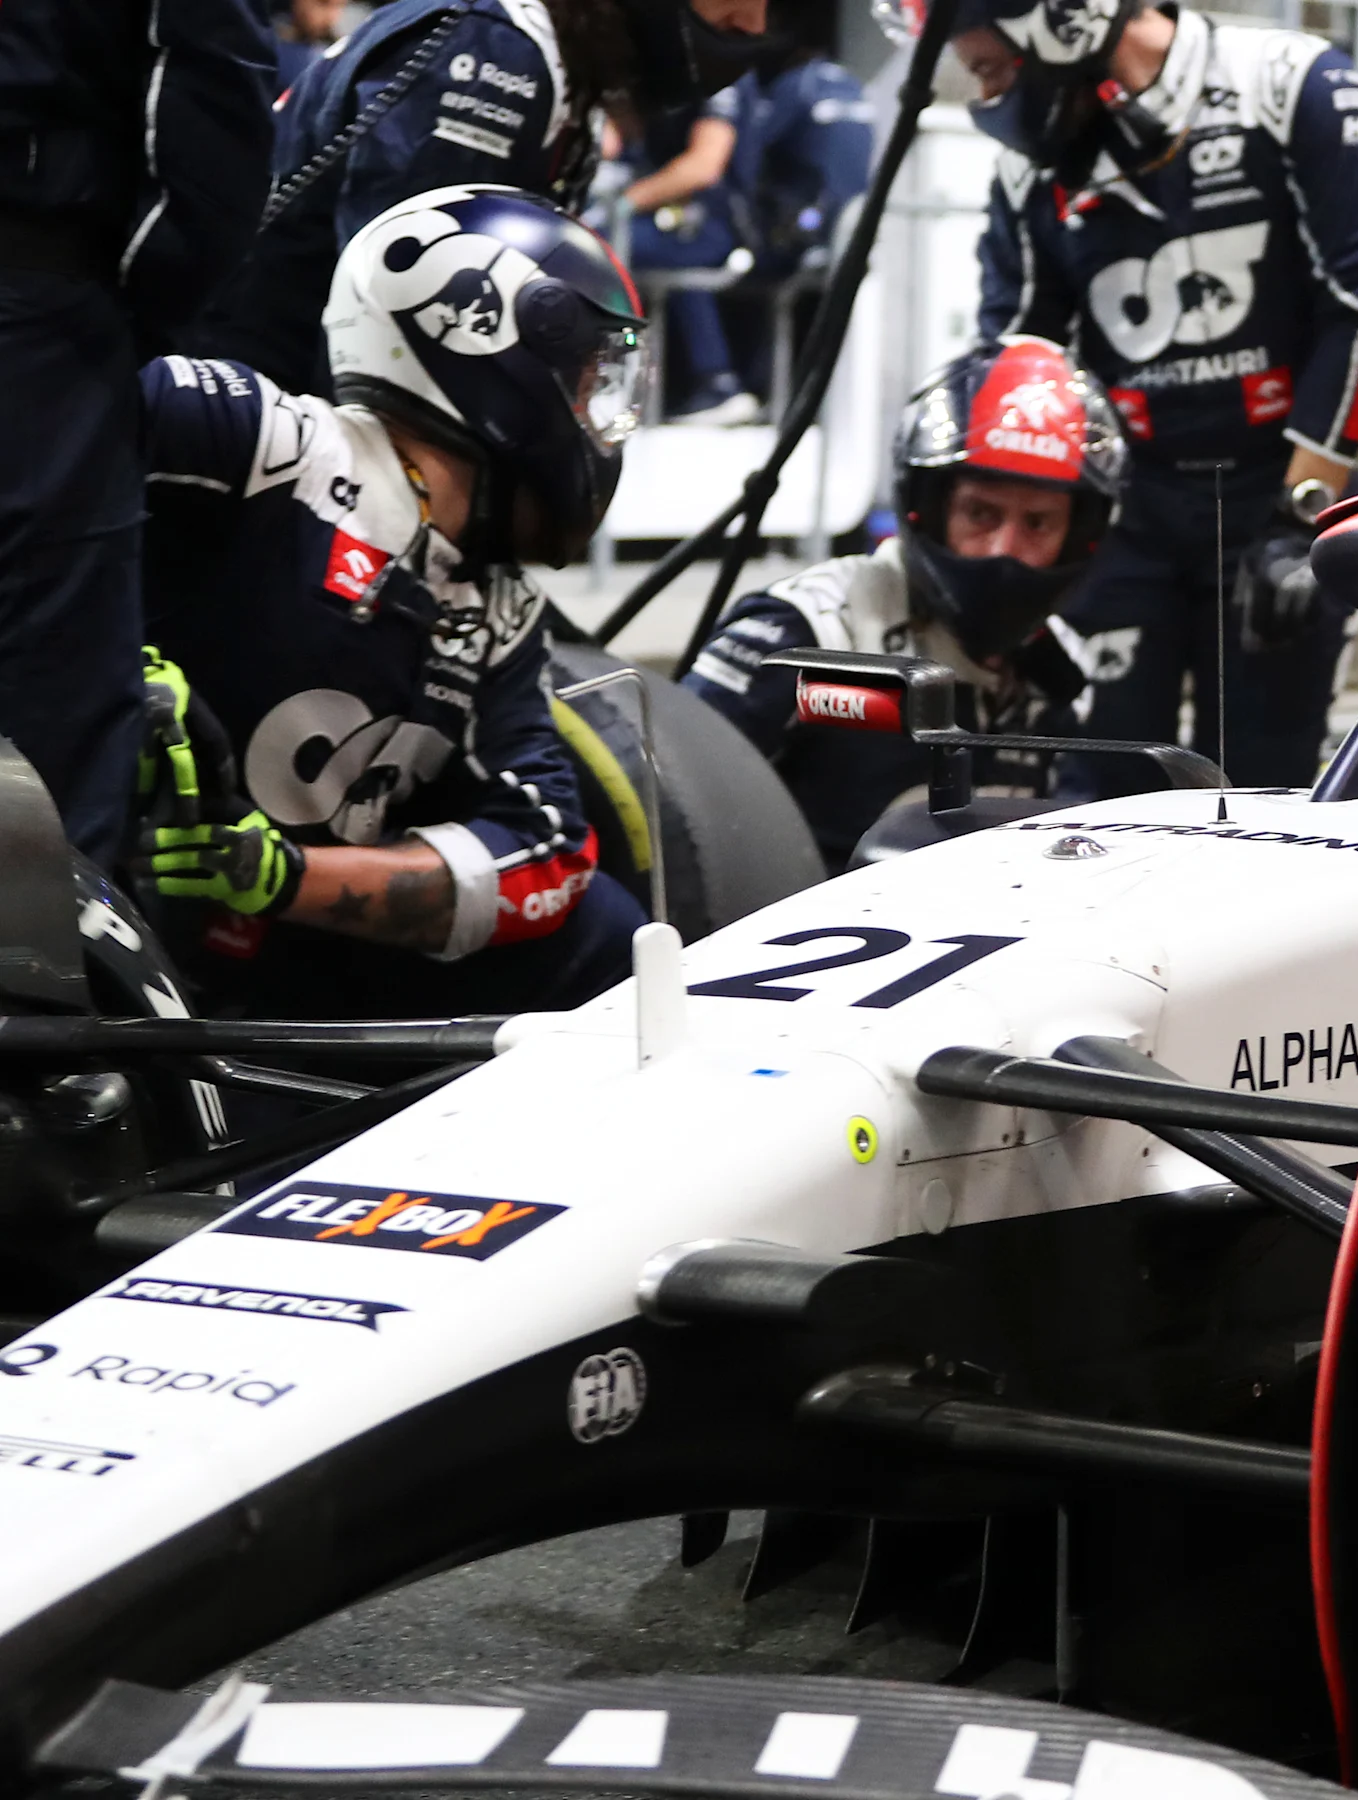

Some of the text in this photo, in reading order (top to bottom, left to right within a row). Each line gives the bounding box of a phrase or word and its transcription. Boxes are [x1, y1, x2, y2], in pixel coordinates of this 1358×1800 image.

[985, 427, 1068, 462] ORLEN
[809, 690, 866, 721] ORLEN
[687, 926, 1027, 1009] 21
[256, 1192, 537, 1250] FLEXBOX
[124, 1280, 369, 1322] RAVENOL
[69, 1355, 297, 1407] Rapid
